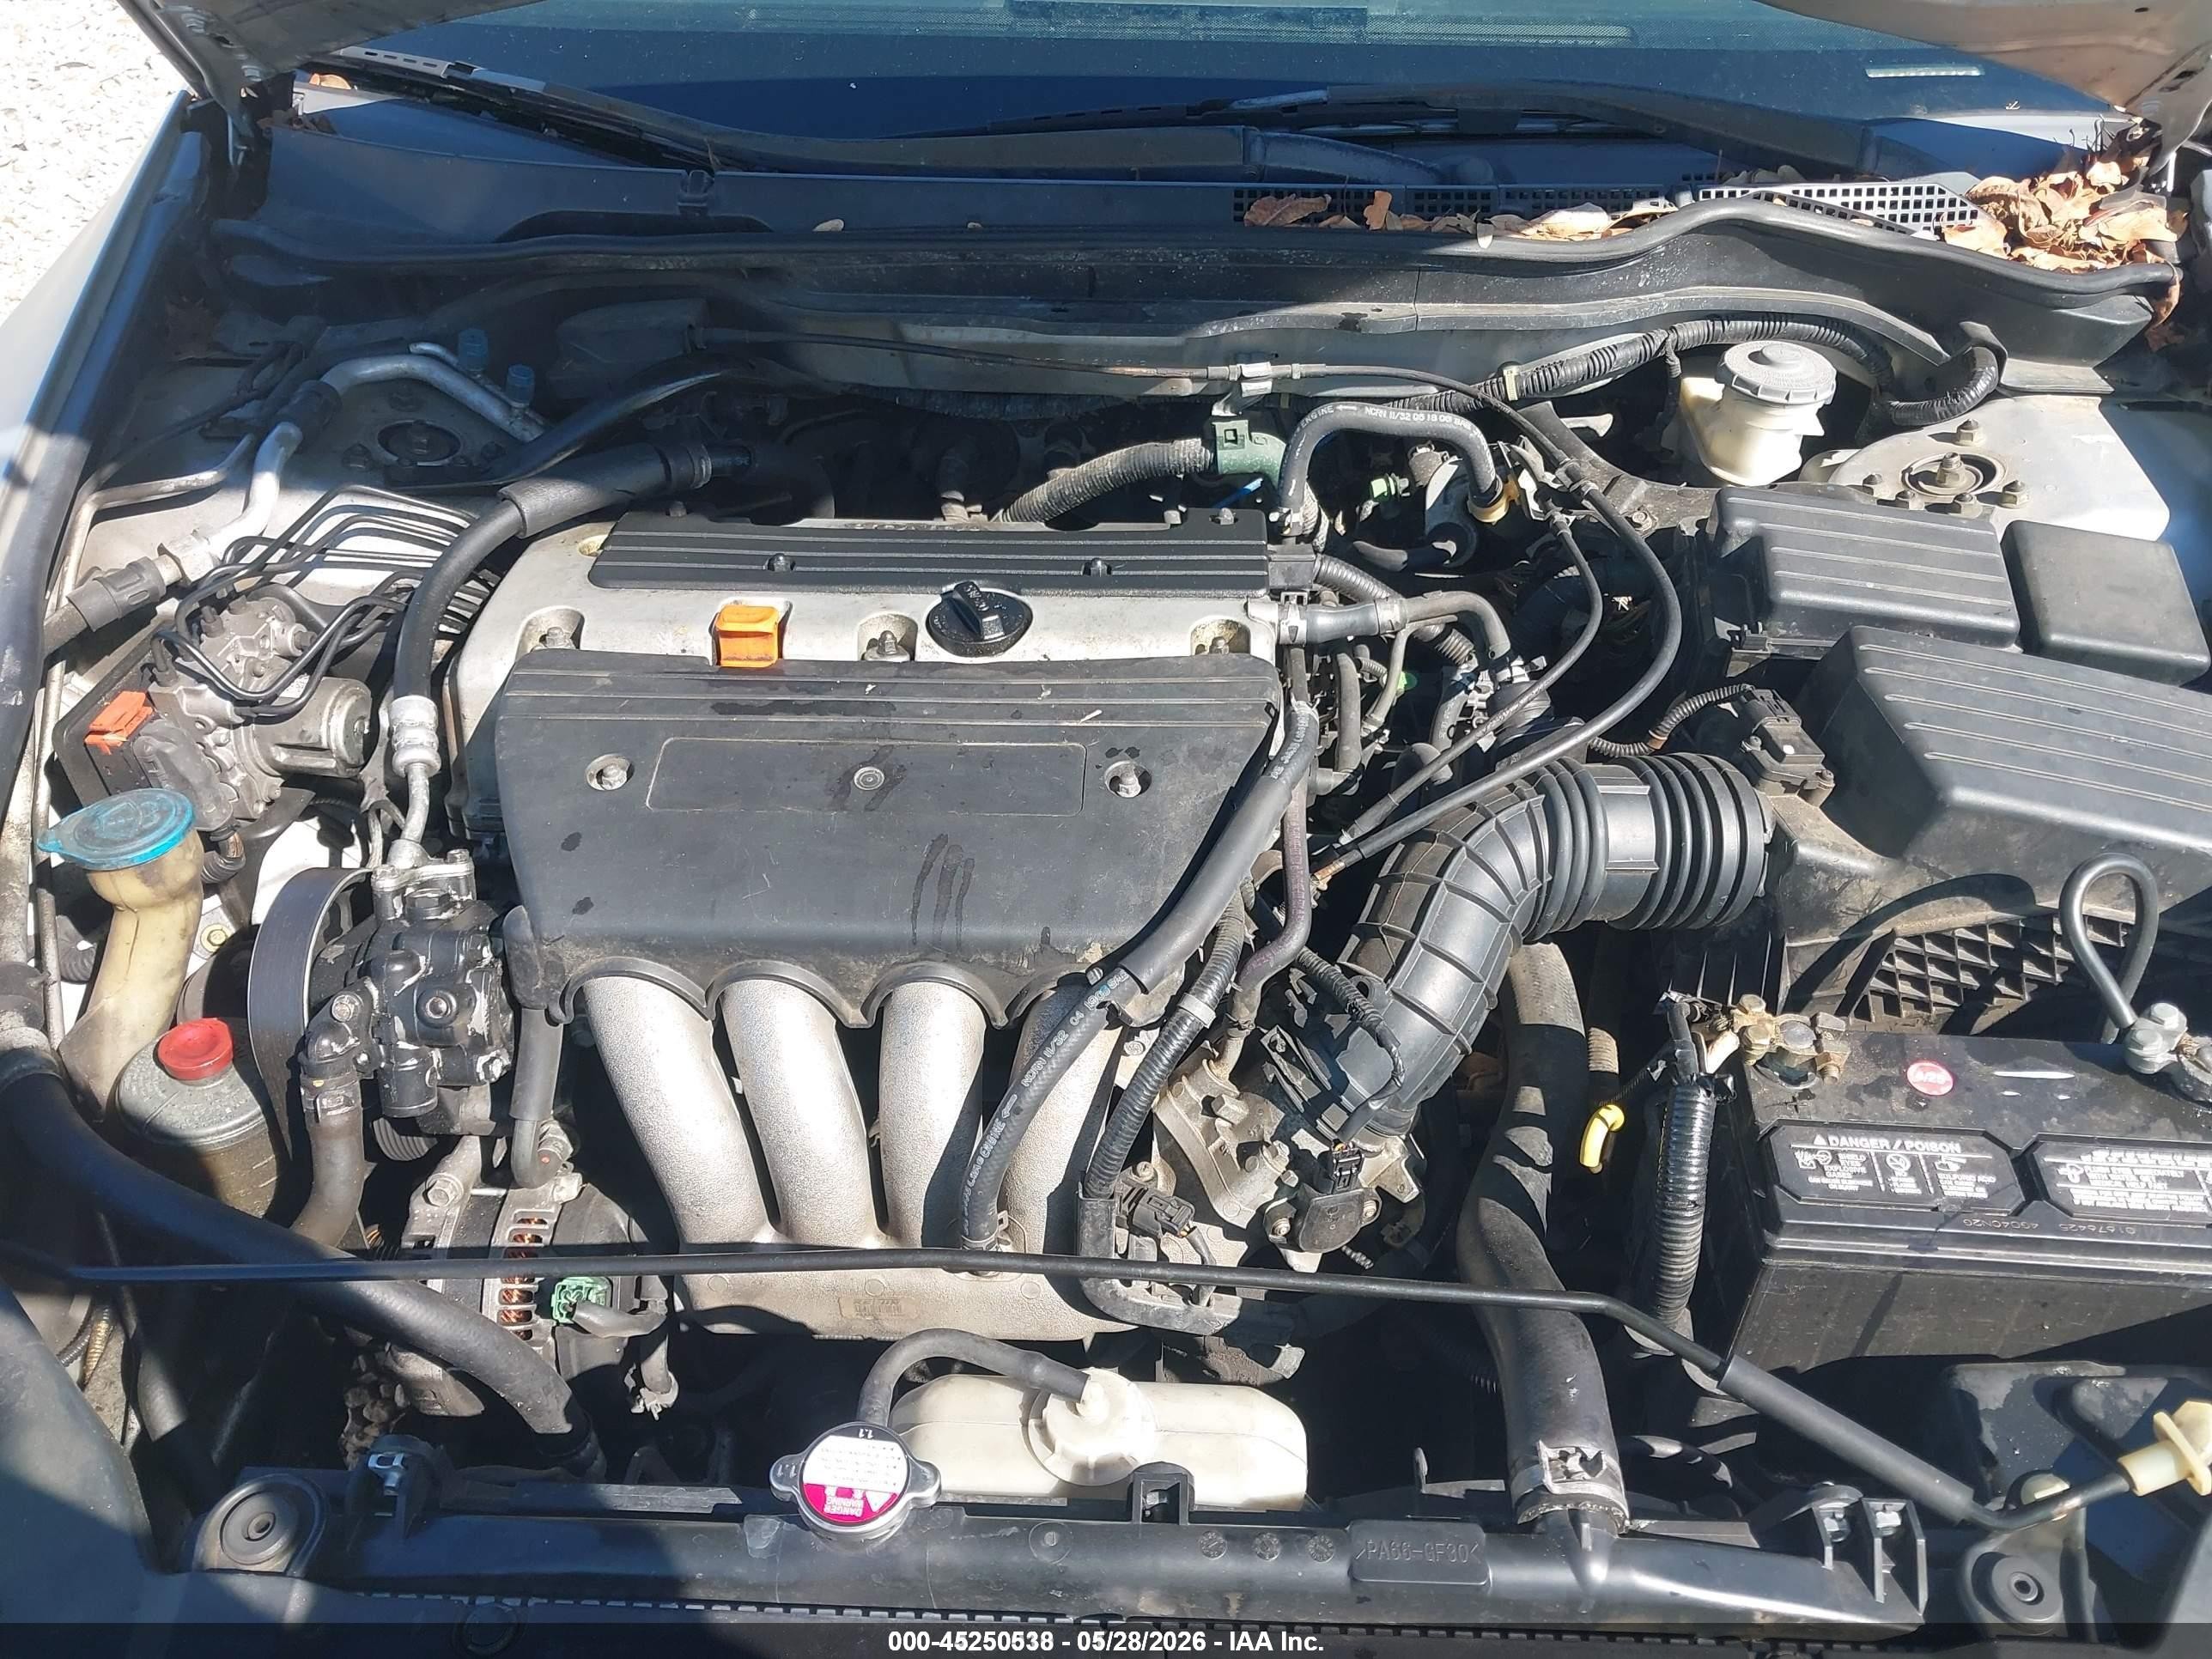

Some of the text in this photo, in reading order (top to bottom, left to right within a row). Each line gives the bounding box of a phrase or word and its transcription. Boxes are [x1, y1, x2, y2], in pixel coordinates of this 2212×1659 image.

[1300, 404, 1334, 428] ENGINE
[1828, 1135, 1890, 1150] DANGER
[1905, 1139, 1962, 1154] POISON
[859, 1428, 874, 1439] 1.1
[826, 1496, 863, 1509] WARNING
[823, 1504, 863, 1518] DANGER
